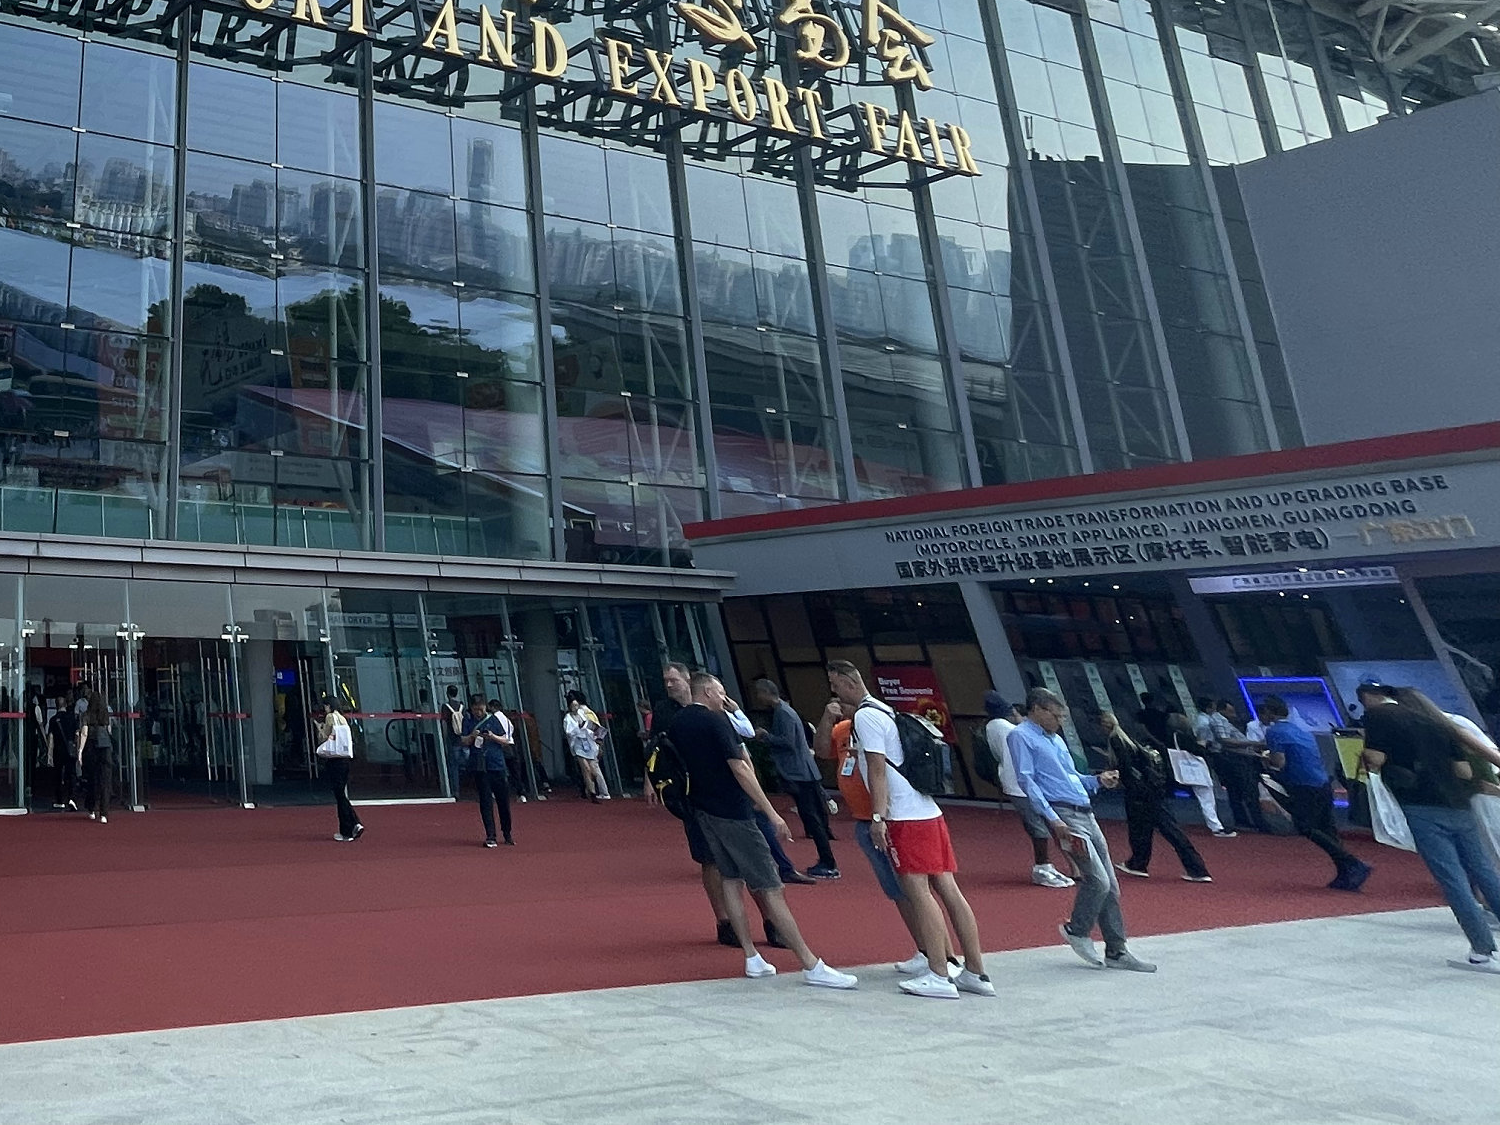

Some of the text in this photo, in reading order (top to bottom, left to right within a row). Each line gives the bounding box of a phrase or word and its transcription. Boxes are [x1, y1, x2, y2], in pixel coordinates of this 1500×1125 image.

[606, 36, 825, 140] EXPORT
[859, 100, 982, 176] FAIR
[884, 474, 1449, 544] NATIONAL FOREIGN TRADE TRANSFORMATION AND UPGRADING BASE
[915, 536, 1017, 557] (MOTORCYCLE,
[1017, 531, 1070, 548] SMART
[1072, 521, 1168, 544] APPLIANCE)
